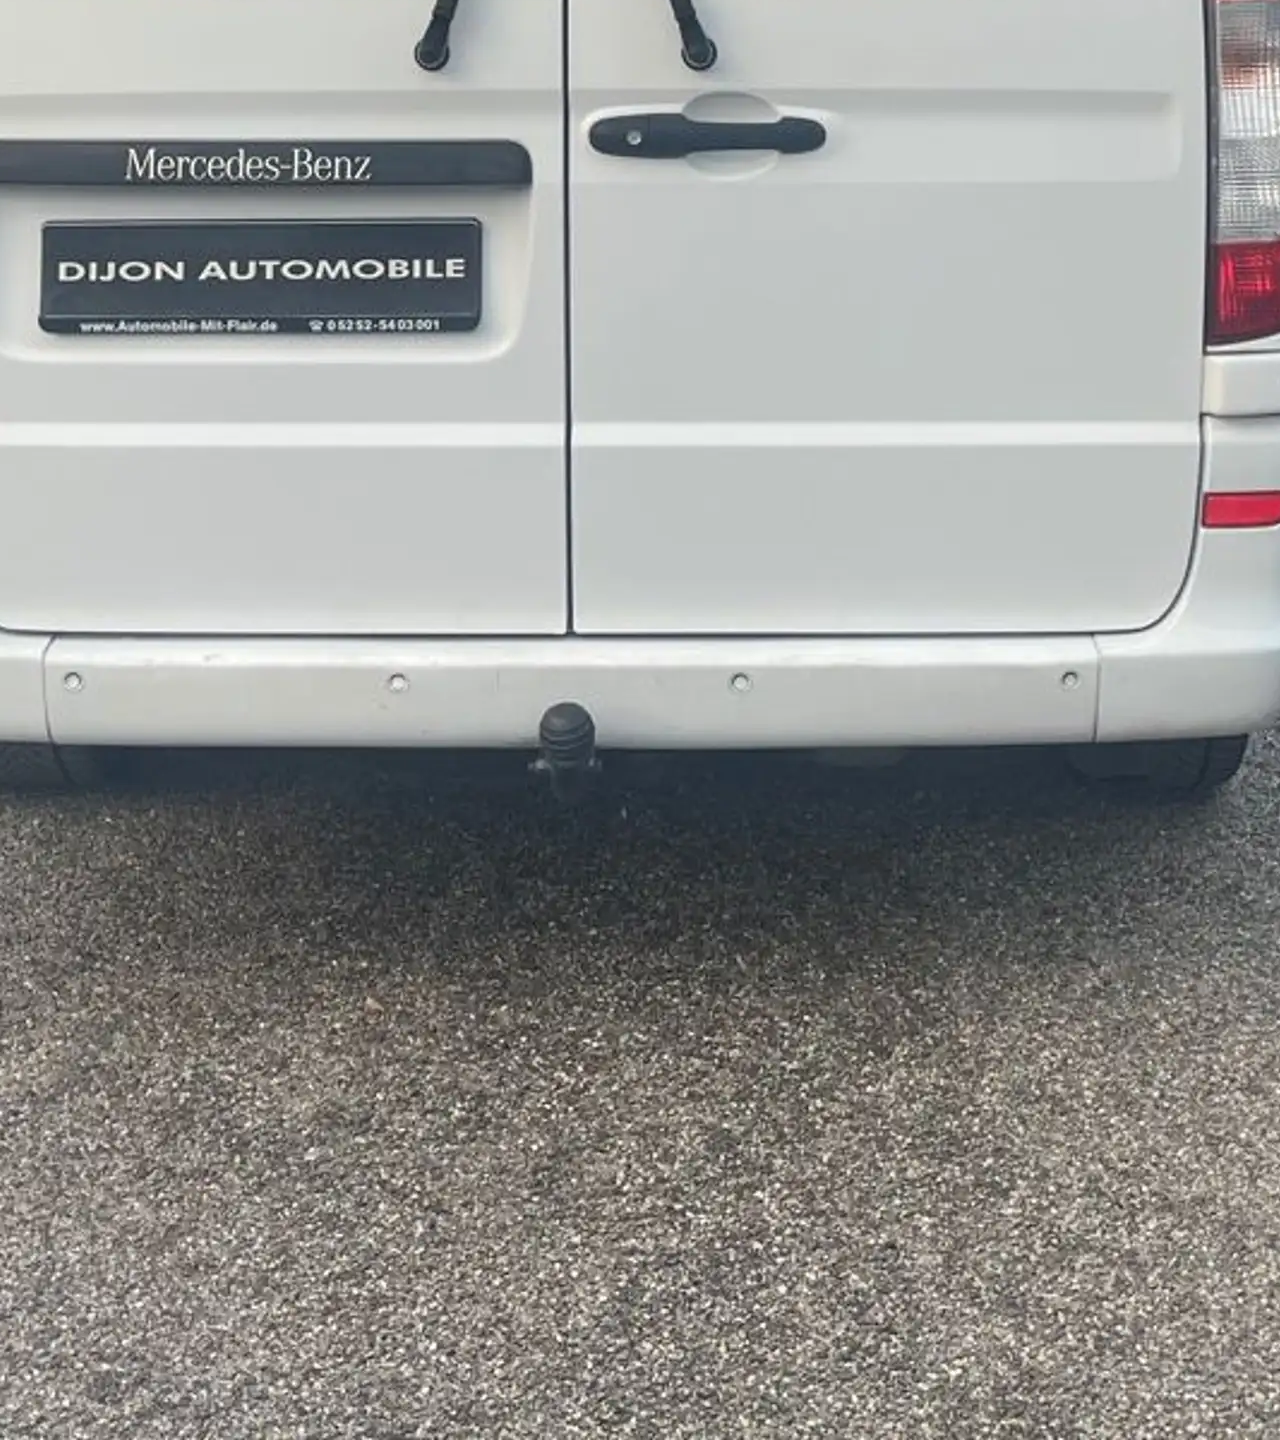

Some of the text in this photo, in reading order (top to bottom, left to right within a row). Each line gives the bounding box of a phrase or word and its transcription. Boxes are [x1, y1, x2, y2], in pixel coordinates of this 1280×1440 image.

[124, 146, 372, 182] Mercedes-Benz
[57, 258, 467, 282] DIJON AUTOMOBILE
